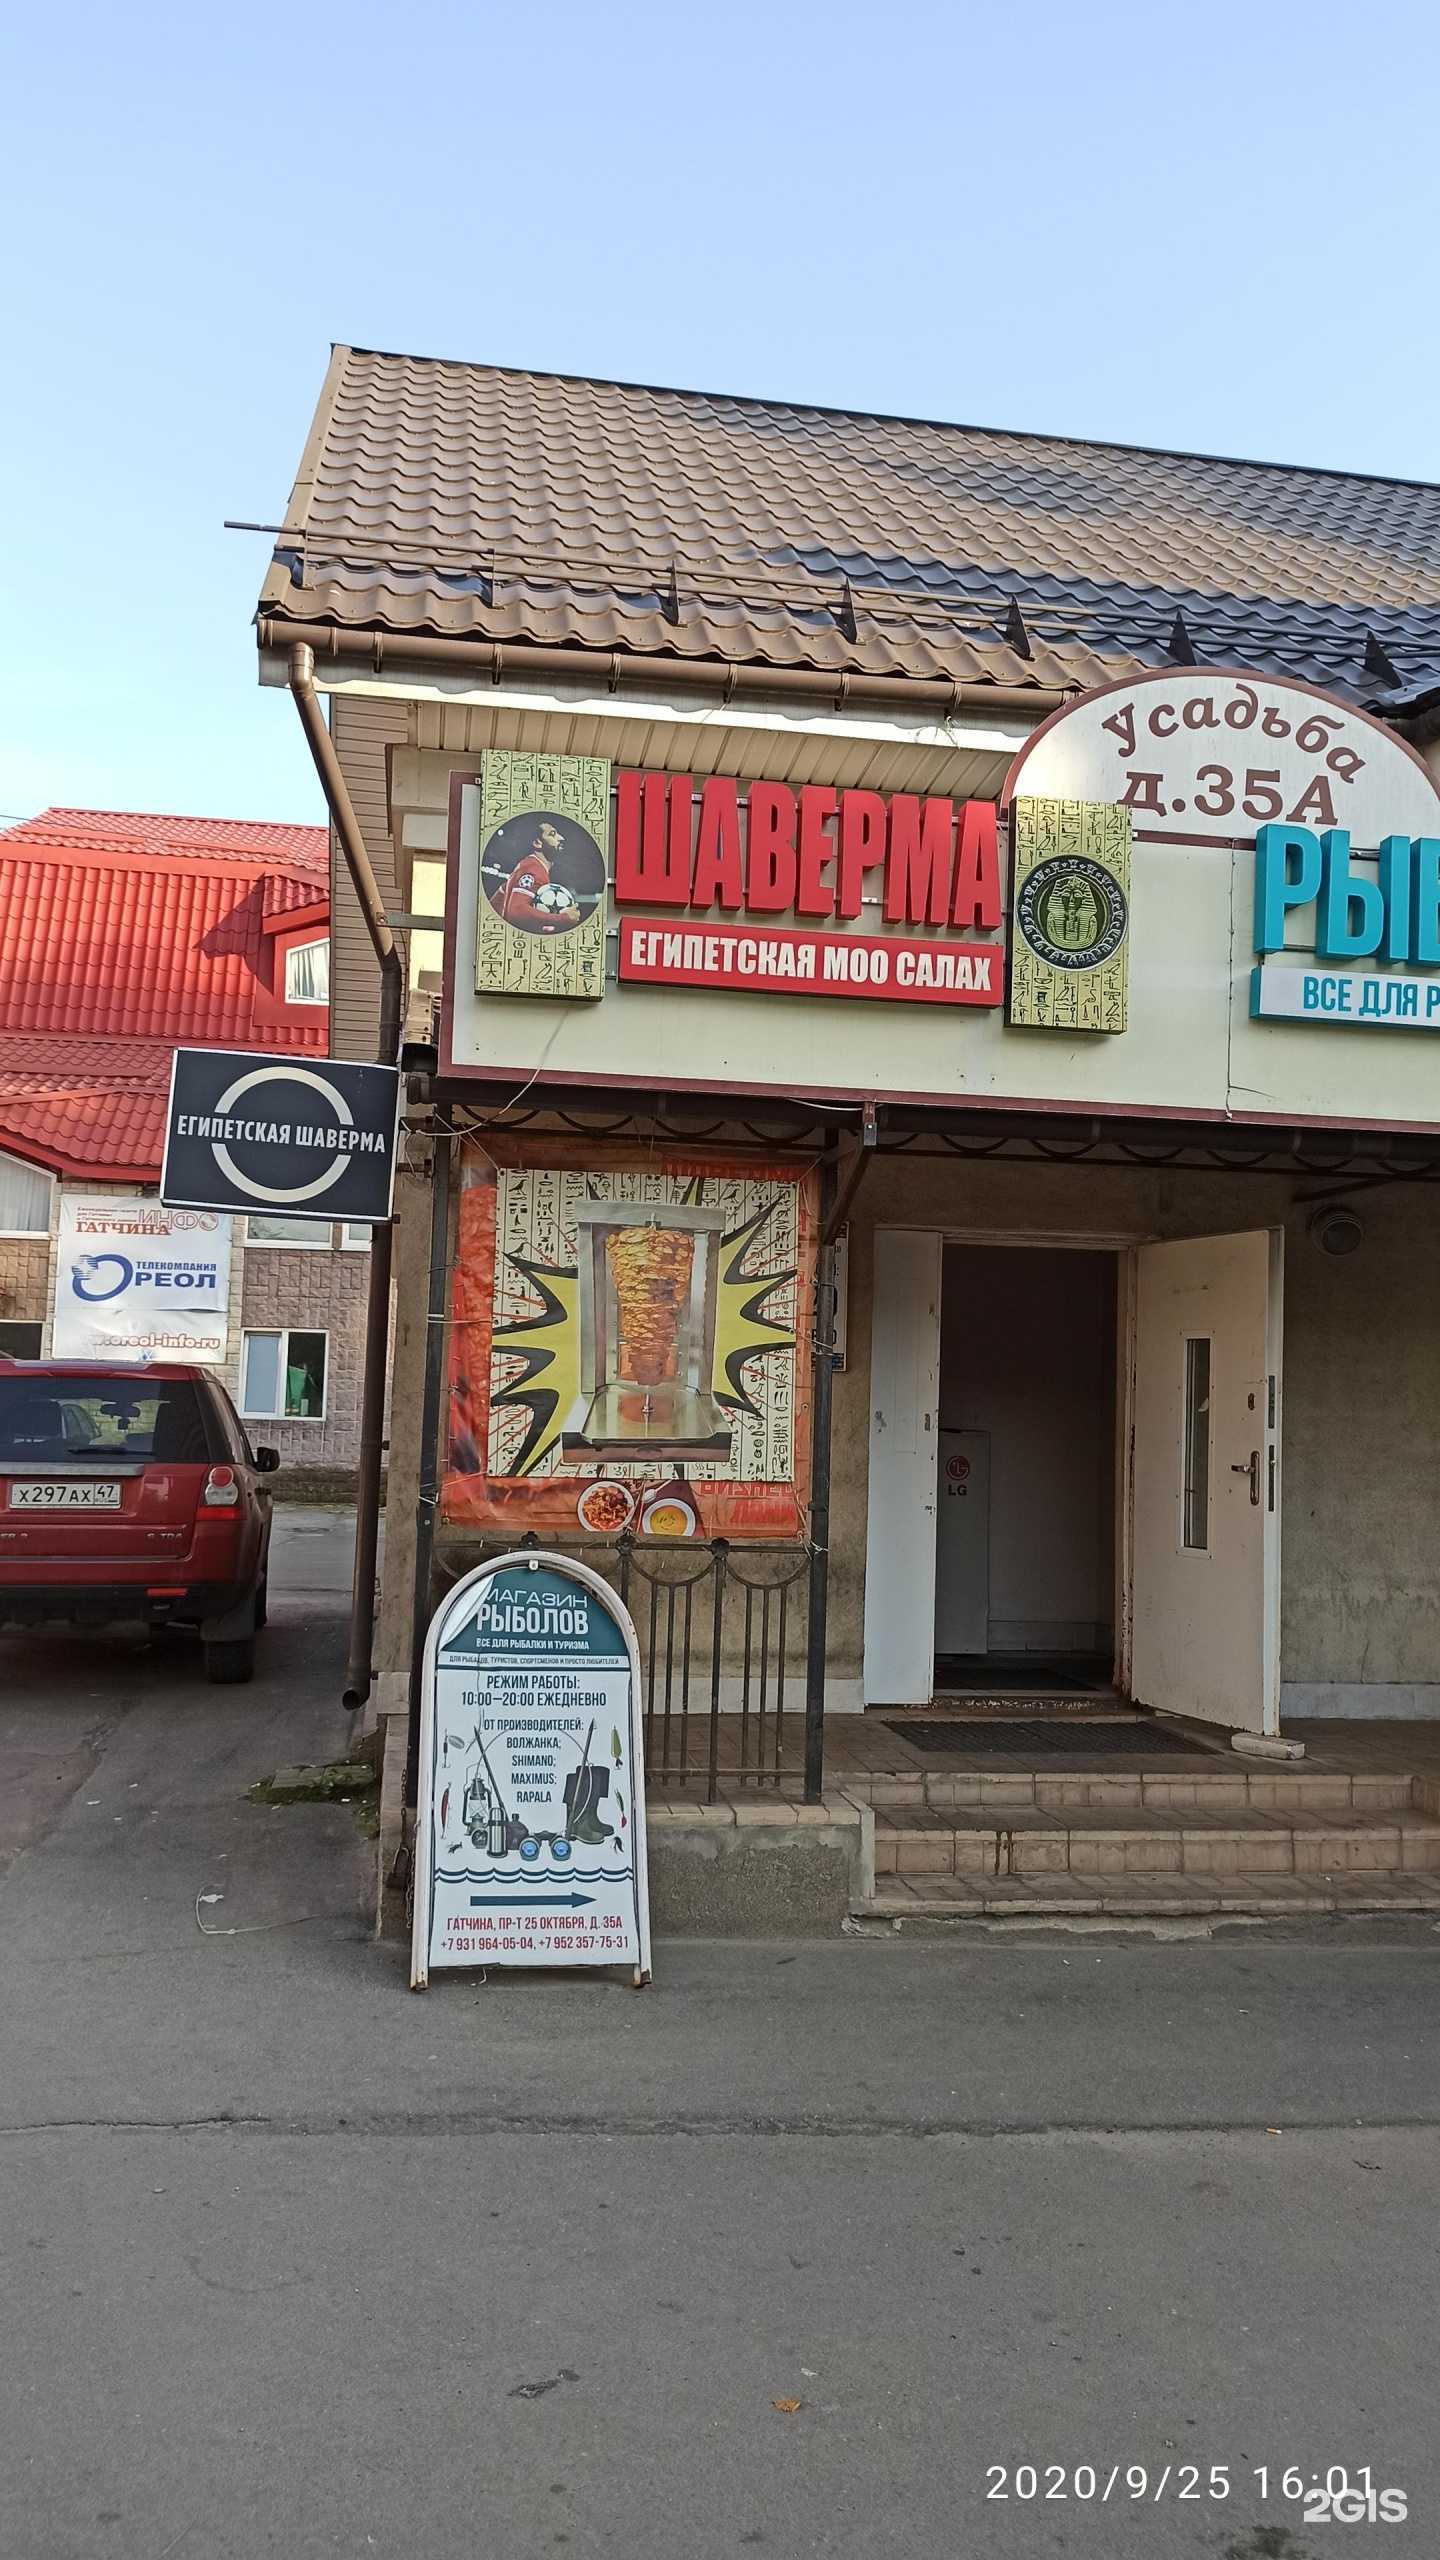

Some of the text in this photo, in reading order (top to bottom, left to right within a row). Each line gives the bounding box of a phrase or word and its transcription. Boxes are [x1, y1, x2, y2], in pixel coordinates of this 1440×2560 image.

[1101, 684, 1366, 784] Усадьба
[614, 772, 1001, 931] ШАВЕРМА
[631, 930, 992, 992] ЕГИПЕТСКАЯ МОО САЛАХ
[1303, 976, 1352, 1012] ВСЕ
[1359, 980, 1418, 1017] ДЛЯ
[177, 1115, 386, 1153] ЕГИПЕТСКАЯ ШАВЕРМА
[75, 1208, 220, 1236] ГАТЧИНА ИНФО
[136, 1261, 217, 1272] ТЕЛЕКОМПАНИЯ
[97, 1485, 114, 1498] 47
[948, 1484, 967, 1496] LG
[477, 1603, 589, 1635] РЫБОЛОВ
[476, 1637, 590, 1650] ВСЕ ДЛЯ РЫБАЛКИ И ТУРИЗМА
[487, 1675, 580, 1689] РЕЖИМ РАБОТЫ:
[537, 1692, 607, 1708] ЕЖЕДНЕВНО
[484, 1717, 584, 1732] ОТ ПРОИЗВОДИТЕЛЕЙ:
[516, 1791, 552, 1803] RAPALA
[447, 1915, 623, 1931] ГАТЧИНА, ПР-Т 25 ОКТЯБРЯ, Д. 35А
[441, 1935, 629, 1951] +7 931 964-05-04, +7 952 357-75-31
